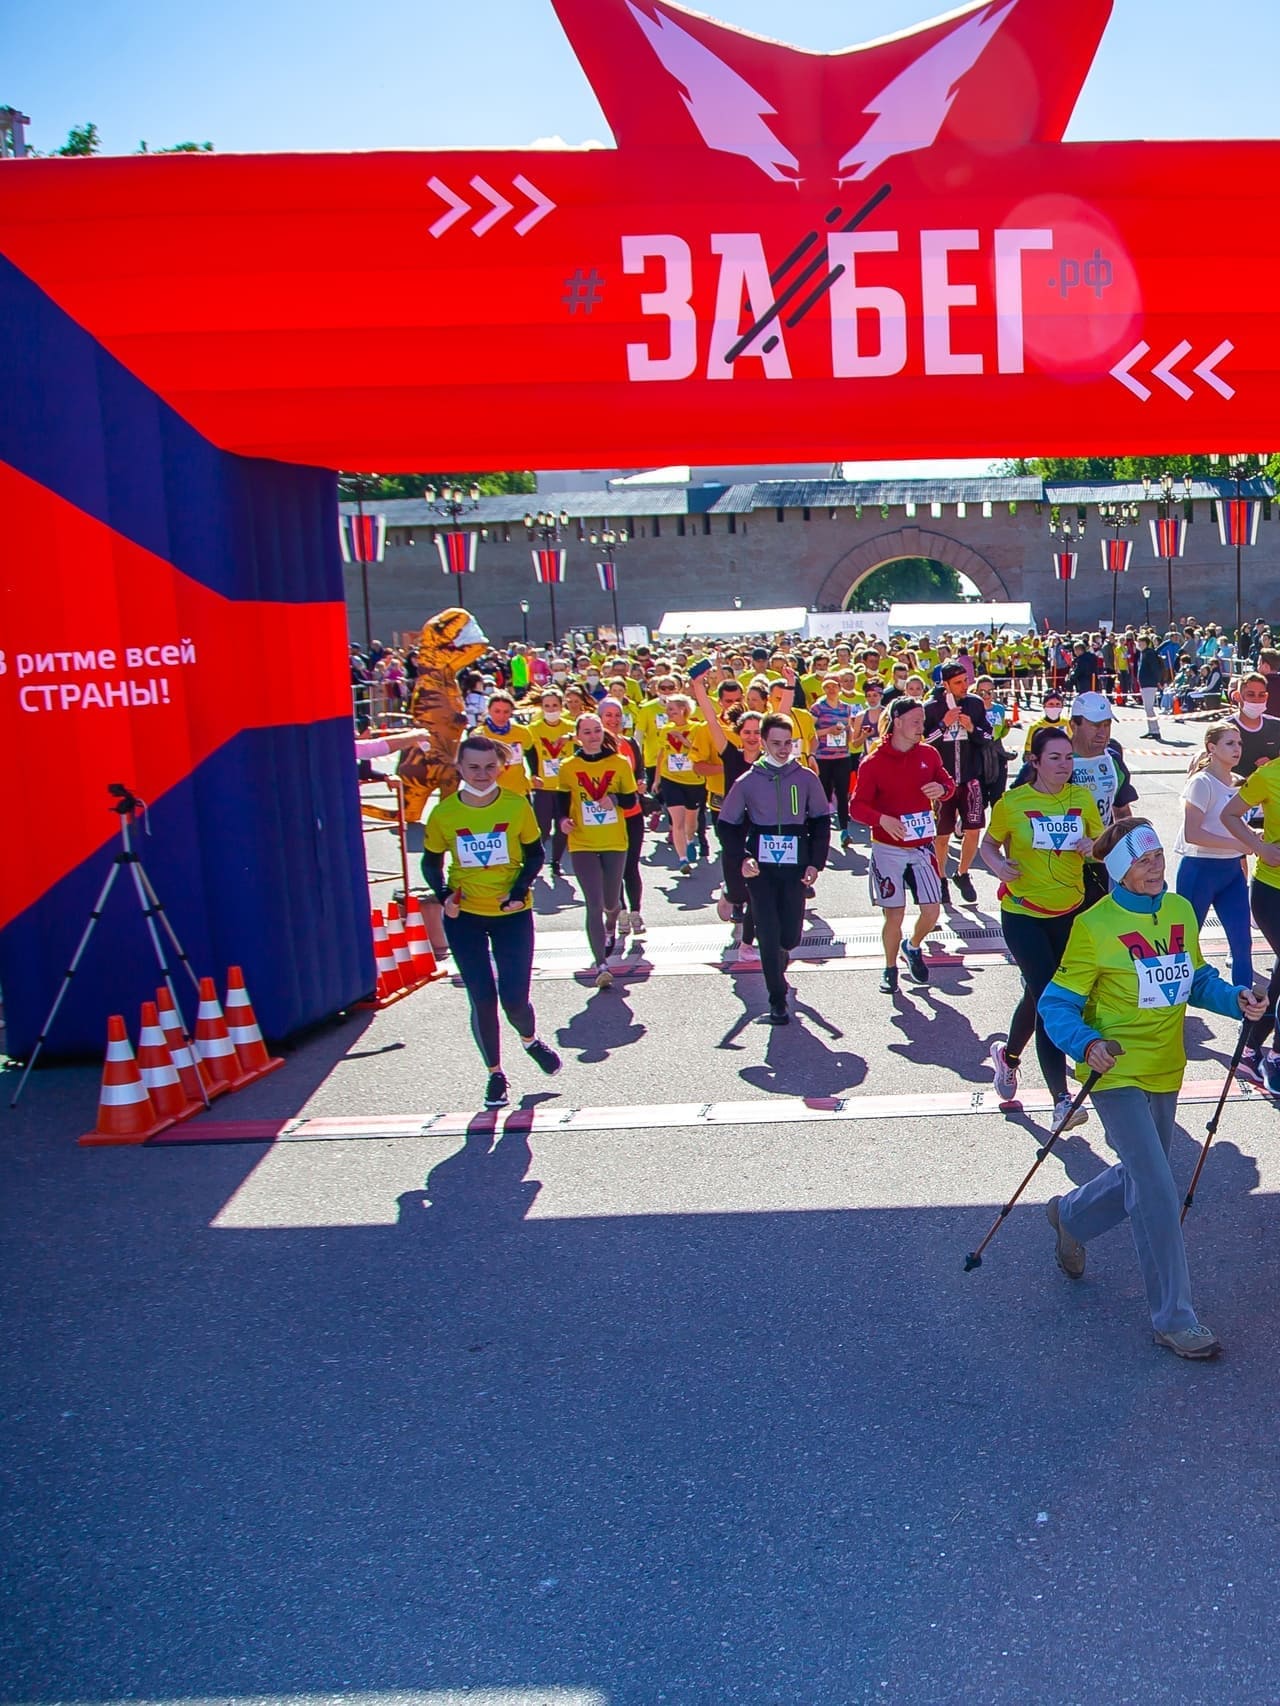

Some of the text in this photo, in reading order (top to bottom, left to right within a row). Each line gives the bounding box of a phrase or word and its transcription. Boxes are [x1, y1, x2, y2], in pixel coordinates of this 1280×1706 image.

[16, 648, 117, 678] ритме
[125, 638, 197, 668] всей
[19, 678, 171, 712] СТРАНЫ!
[906, 816, 932, 828] 10113
[1038, 822, 1079, 833] 10086
[463, 838, 503, 853] 10040
[763, 841, 794, 851] 10144
[1145, 963, 1190, 984] 10026
